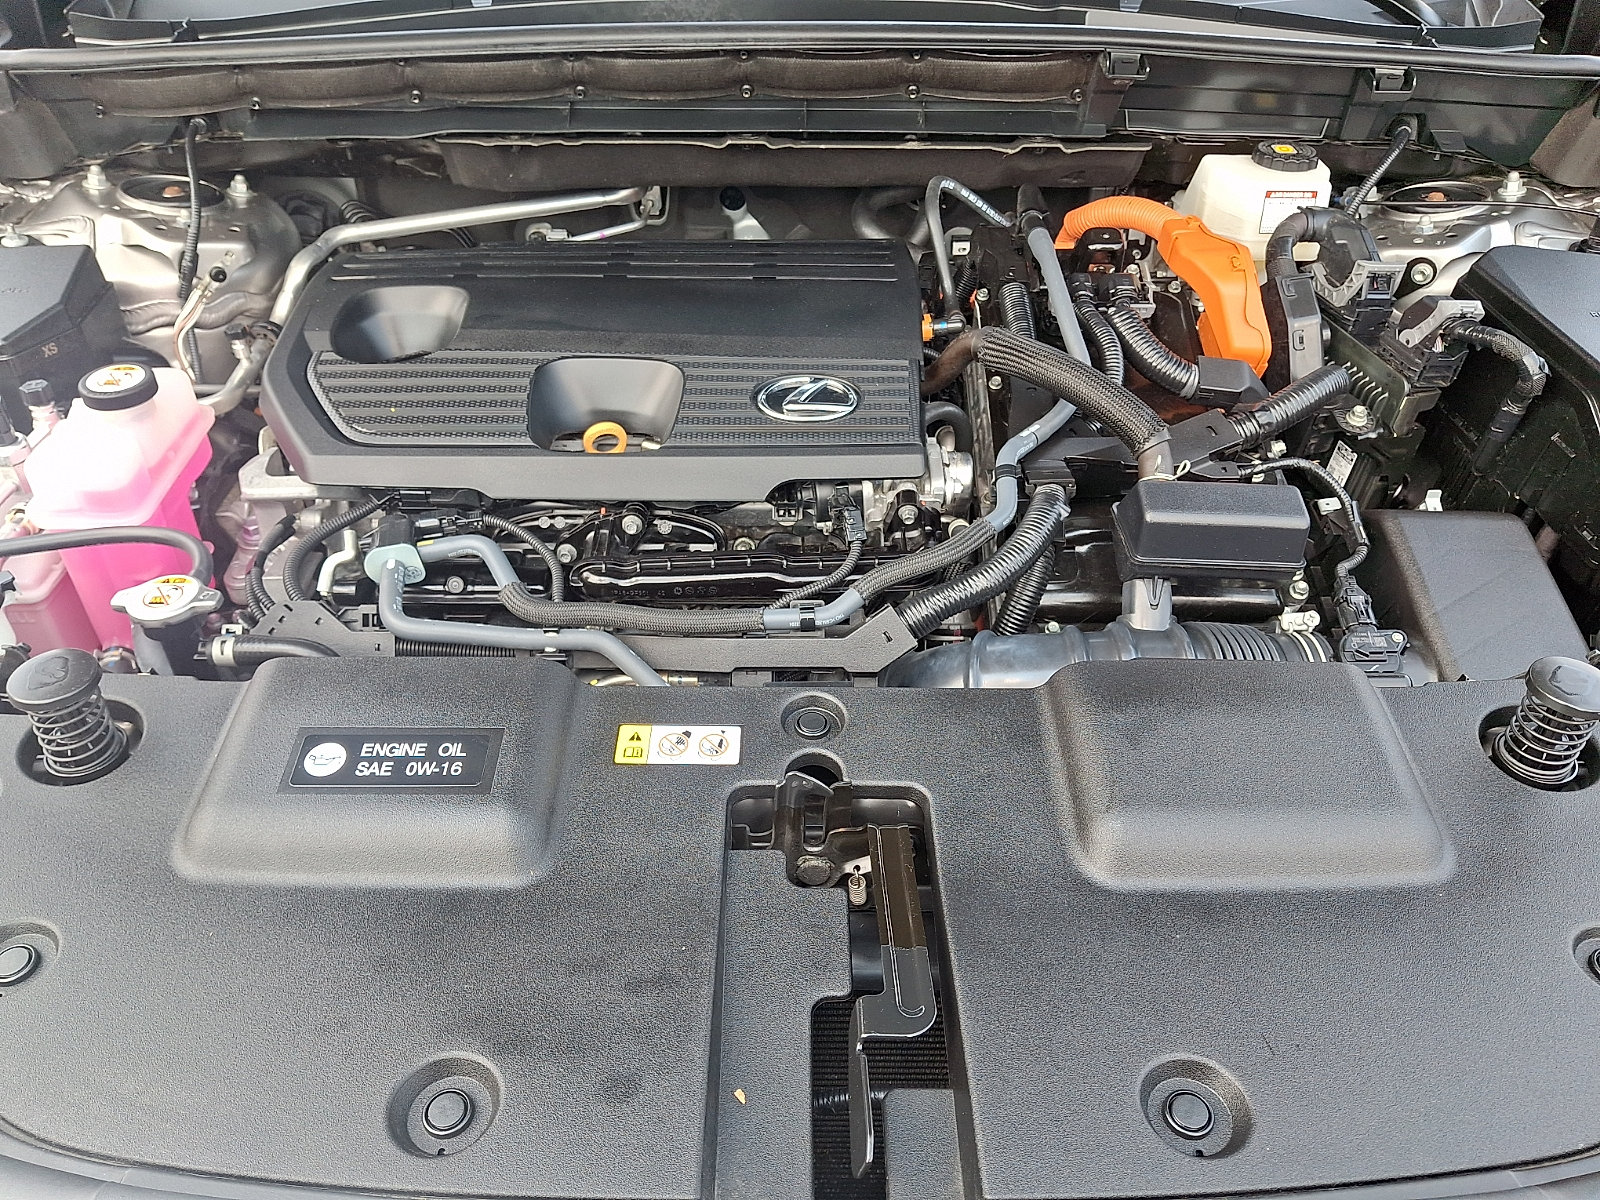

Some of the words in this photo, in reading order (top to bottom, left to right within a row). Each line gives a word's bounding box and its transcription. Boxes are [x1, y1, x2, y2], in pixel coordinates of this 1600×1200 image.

[360, 743, 428, 757] ENGINE
[438, 743, 467, 757] OIL
[355, 761, 394, 776] SAE
[405, 761, 463, 776] 0W-16
